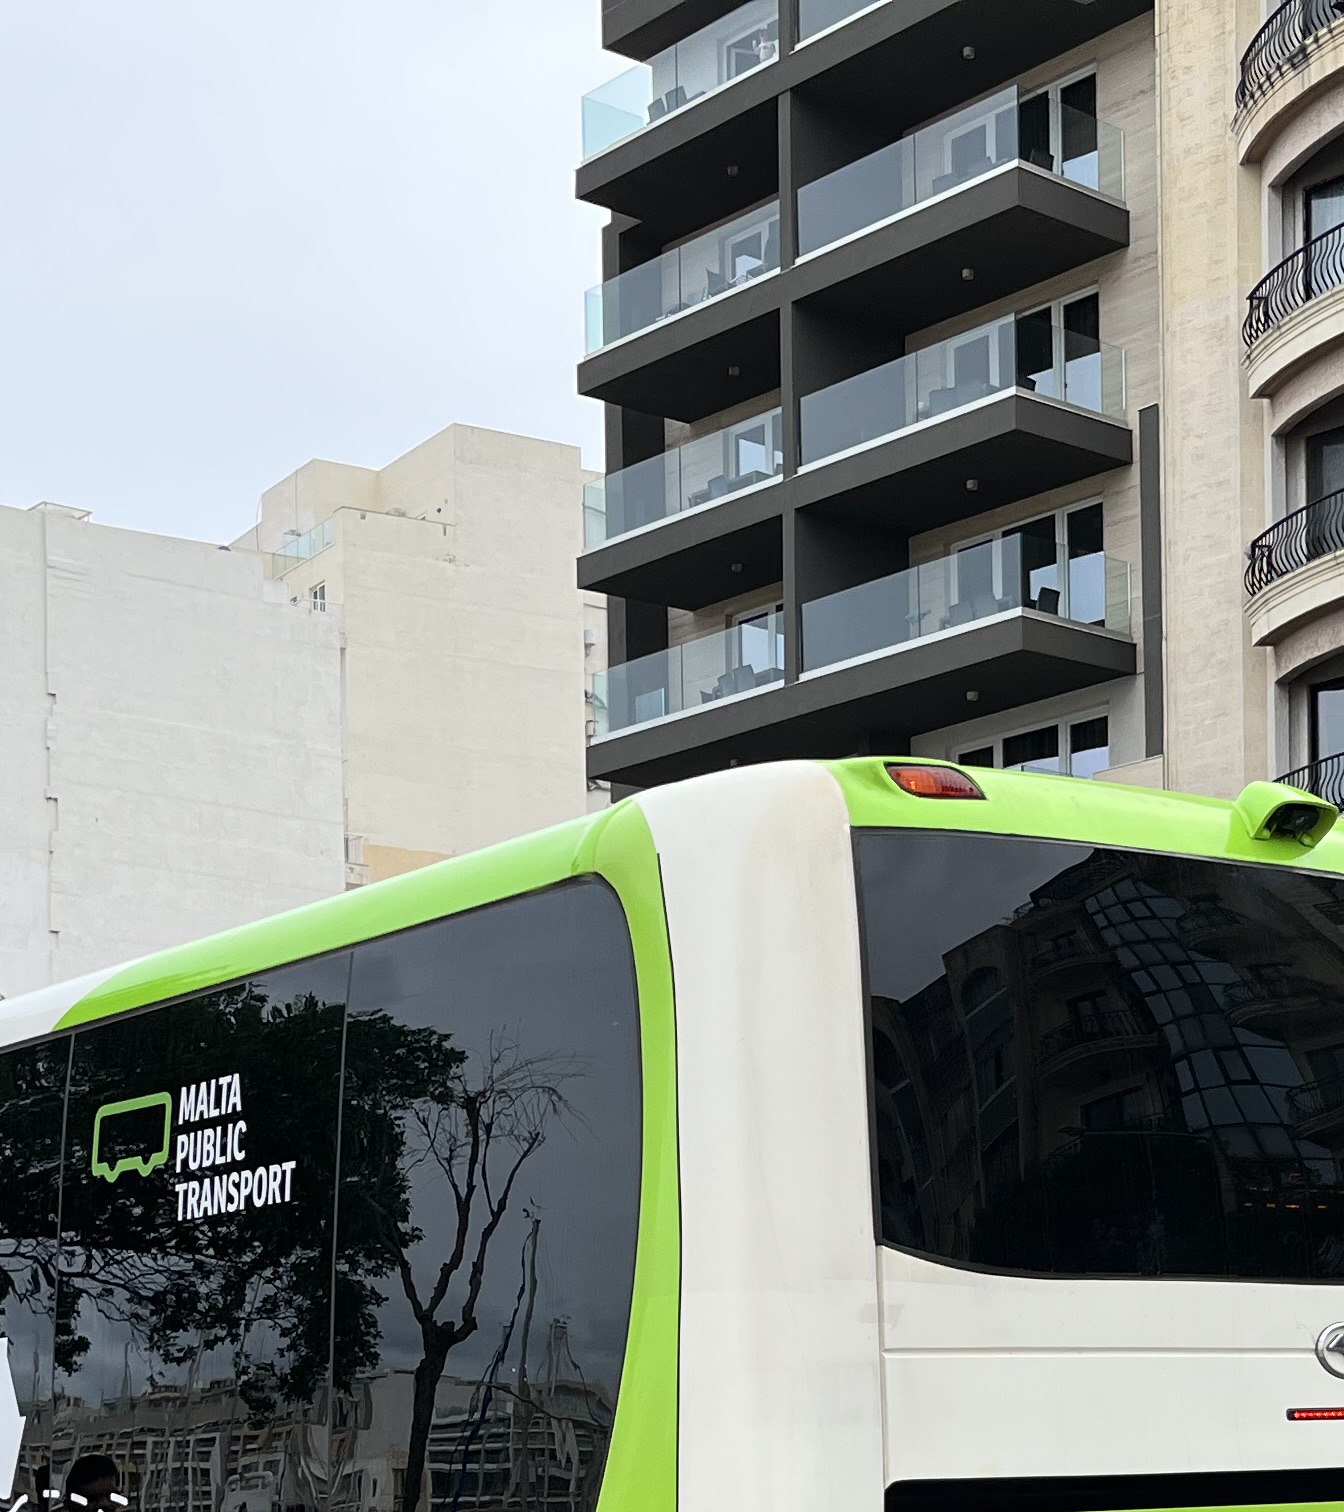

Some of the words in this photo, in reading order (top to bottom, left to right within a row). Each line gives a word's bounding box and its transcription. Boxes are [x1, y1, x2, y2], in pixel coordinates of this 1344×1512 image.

[177, 1073, 242, 1125] MALTA
[175, 1120, 247, 1173] PUBLIC
[174, 1161, 297, 1221] TRANSPORT
